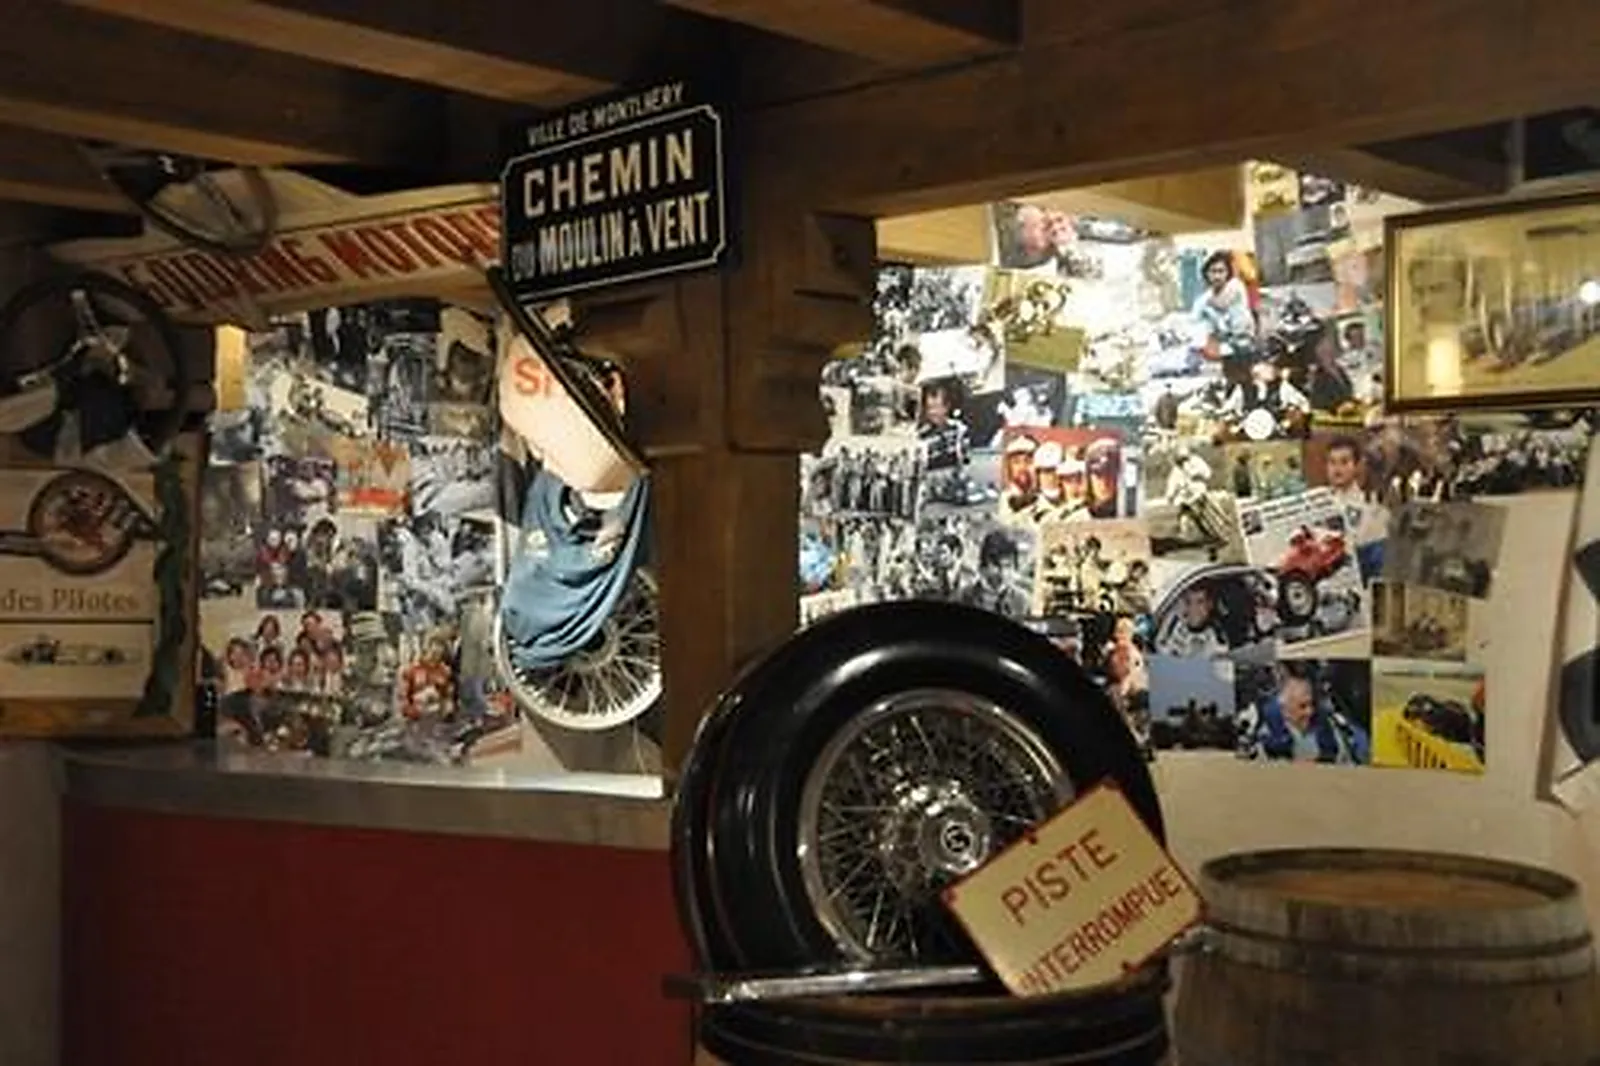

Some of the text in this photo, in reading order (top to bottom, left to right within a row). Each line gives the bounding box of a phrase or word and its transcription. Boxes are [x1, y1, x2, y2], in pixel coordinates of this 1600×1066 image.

[523, 128, 694, 220] CHEMIN
[538, 208, 626, 277] MOULIN
[646, 190, 711, 254] VENT
[52, 588, 141, 613] Pilotes
[1001, 828, 1119, 927] PISTE
